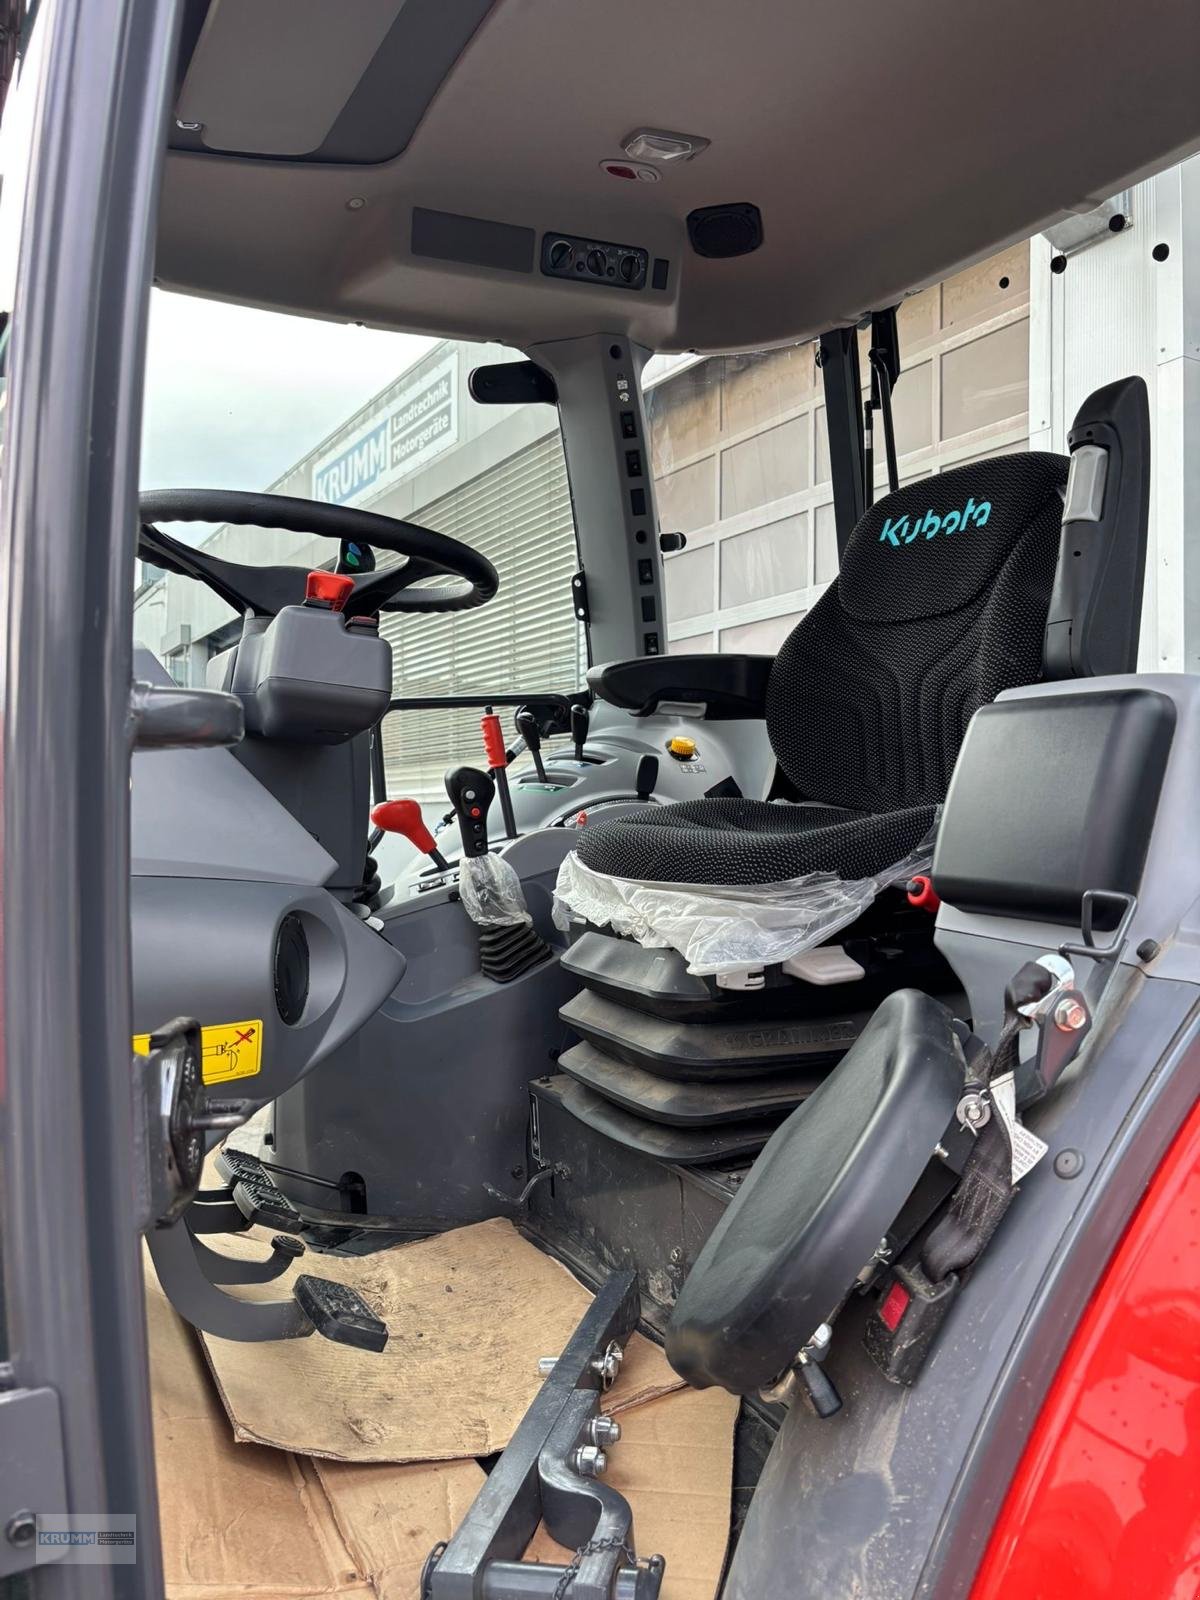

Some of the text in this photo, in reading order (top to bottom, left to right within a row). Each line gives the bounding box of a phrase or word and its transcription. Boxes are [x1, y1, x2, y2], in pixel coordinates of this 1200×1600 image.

[392, 379, 450, 432] Landtechnik
[392, 413, 450, 463] Motorgeräte
[316, 429, 386, 503] KRUMM
[879, 497, 992, 546] Kubota
